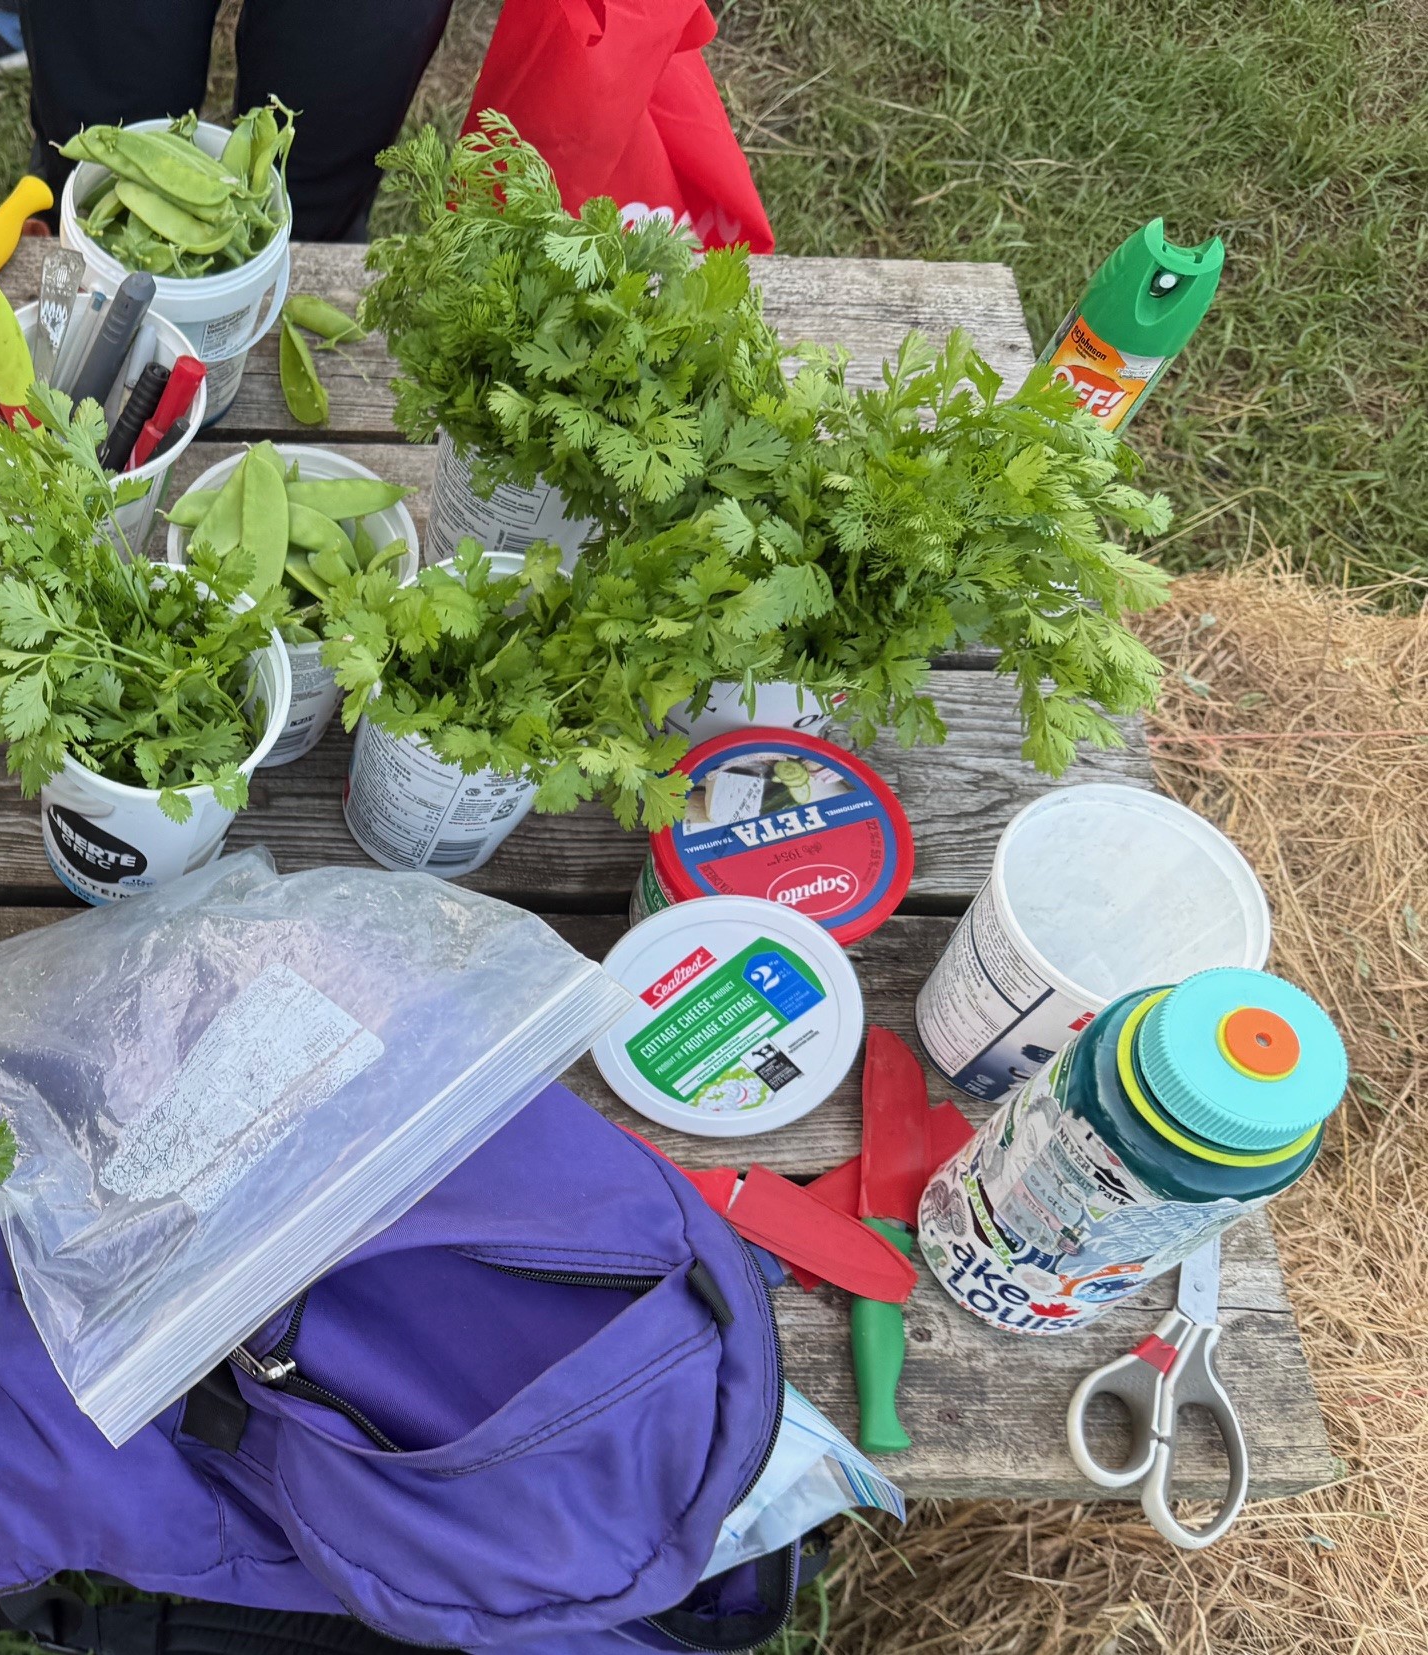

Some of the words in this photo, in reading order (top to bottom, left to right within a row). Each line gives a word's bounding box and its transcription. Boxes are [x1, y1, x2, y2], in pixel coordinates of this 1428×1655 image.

[731, 805, 827, 847] FETA
[61, 832, 111, 871] GREC
[776, 872, 851, 906] Saputo
[651, 951, 706, 1001] Sealtest
[639, 1022, 683, 1060] COTTAGE
[676, 996, 714, 1030] CHEESE
[710, 980, 736, 1004] PRODUCT
[680, 1020, 722, 1057] FROMAGE
[718, 992, 758, 1027] COTTAGE
[1057, 1127, 1092, 1174] NEVER
[952, 1242, 1030, 1305] ake
